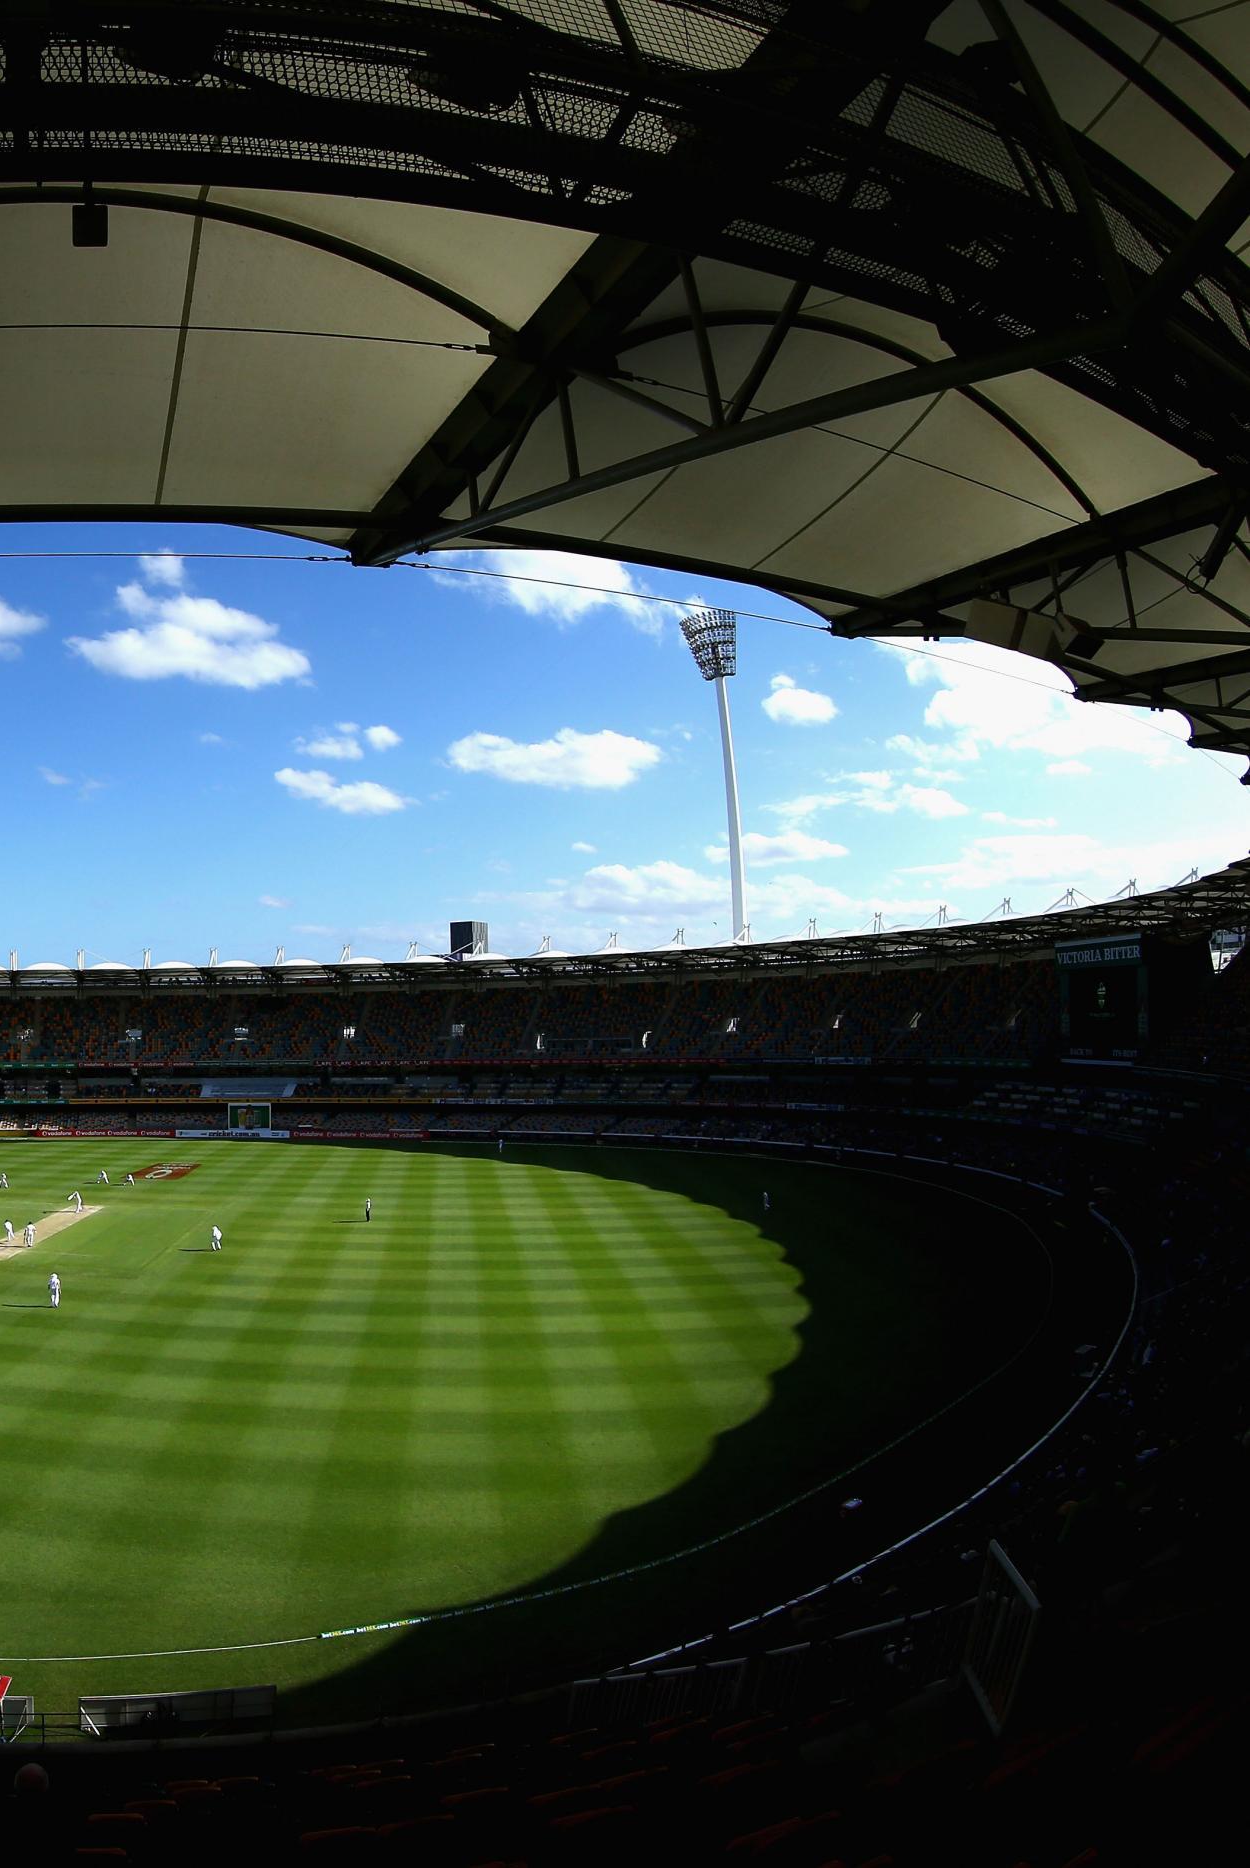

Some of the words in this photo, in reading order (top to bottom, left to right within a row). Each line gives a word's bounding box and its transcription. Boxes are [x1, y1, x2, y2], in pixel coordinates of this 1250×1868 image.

[1057, 949, 1102, 965] VICTORIA
[1104, 945, 1141, 960] BITTER
[321, 1629, 355, 1638] bet365.com
[356, 1623, 389, 1633] bet365.com
[389, 1618, 421, 1628] bet365.com
